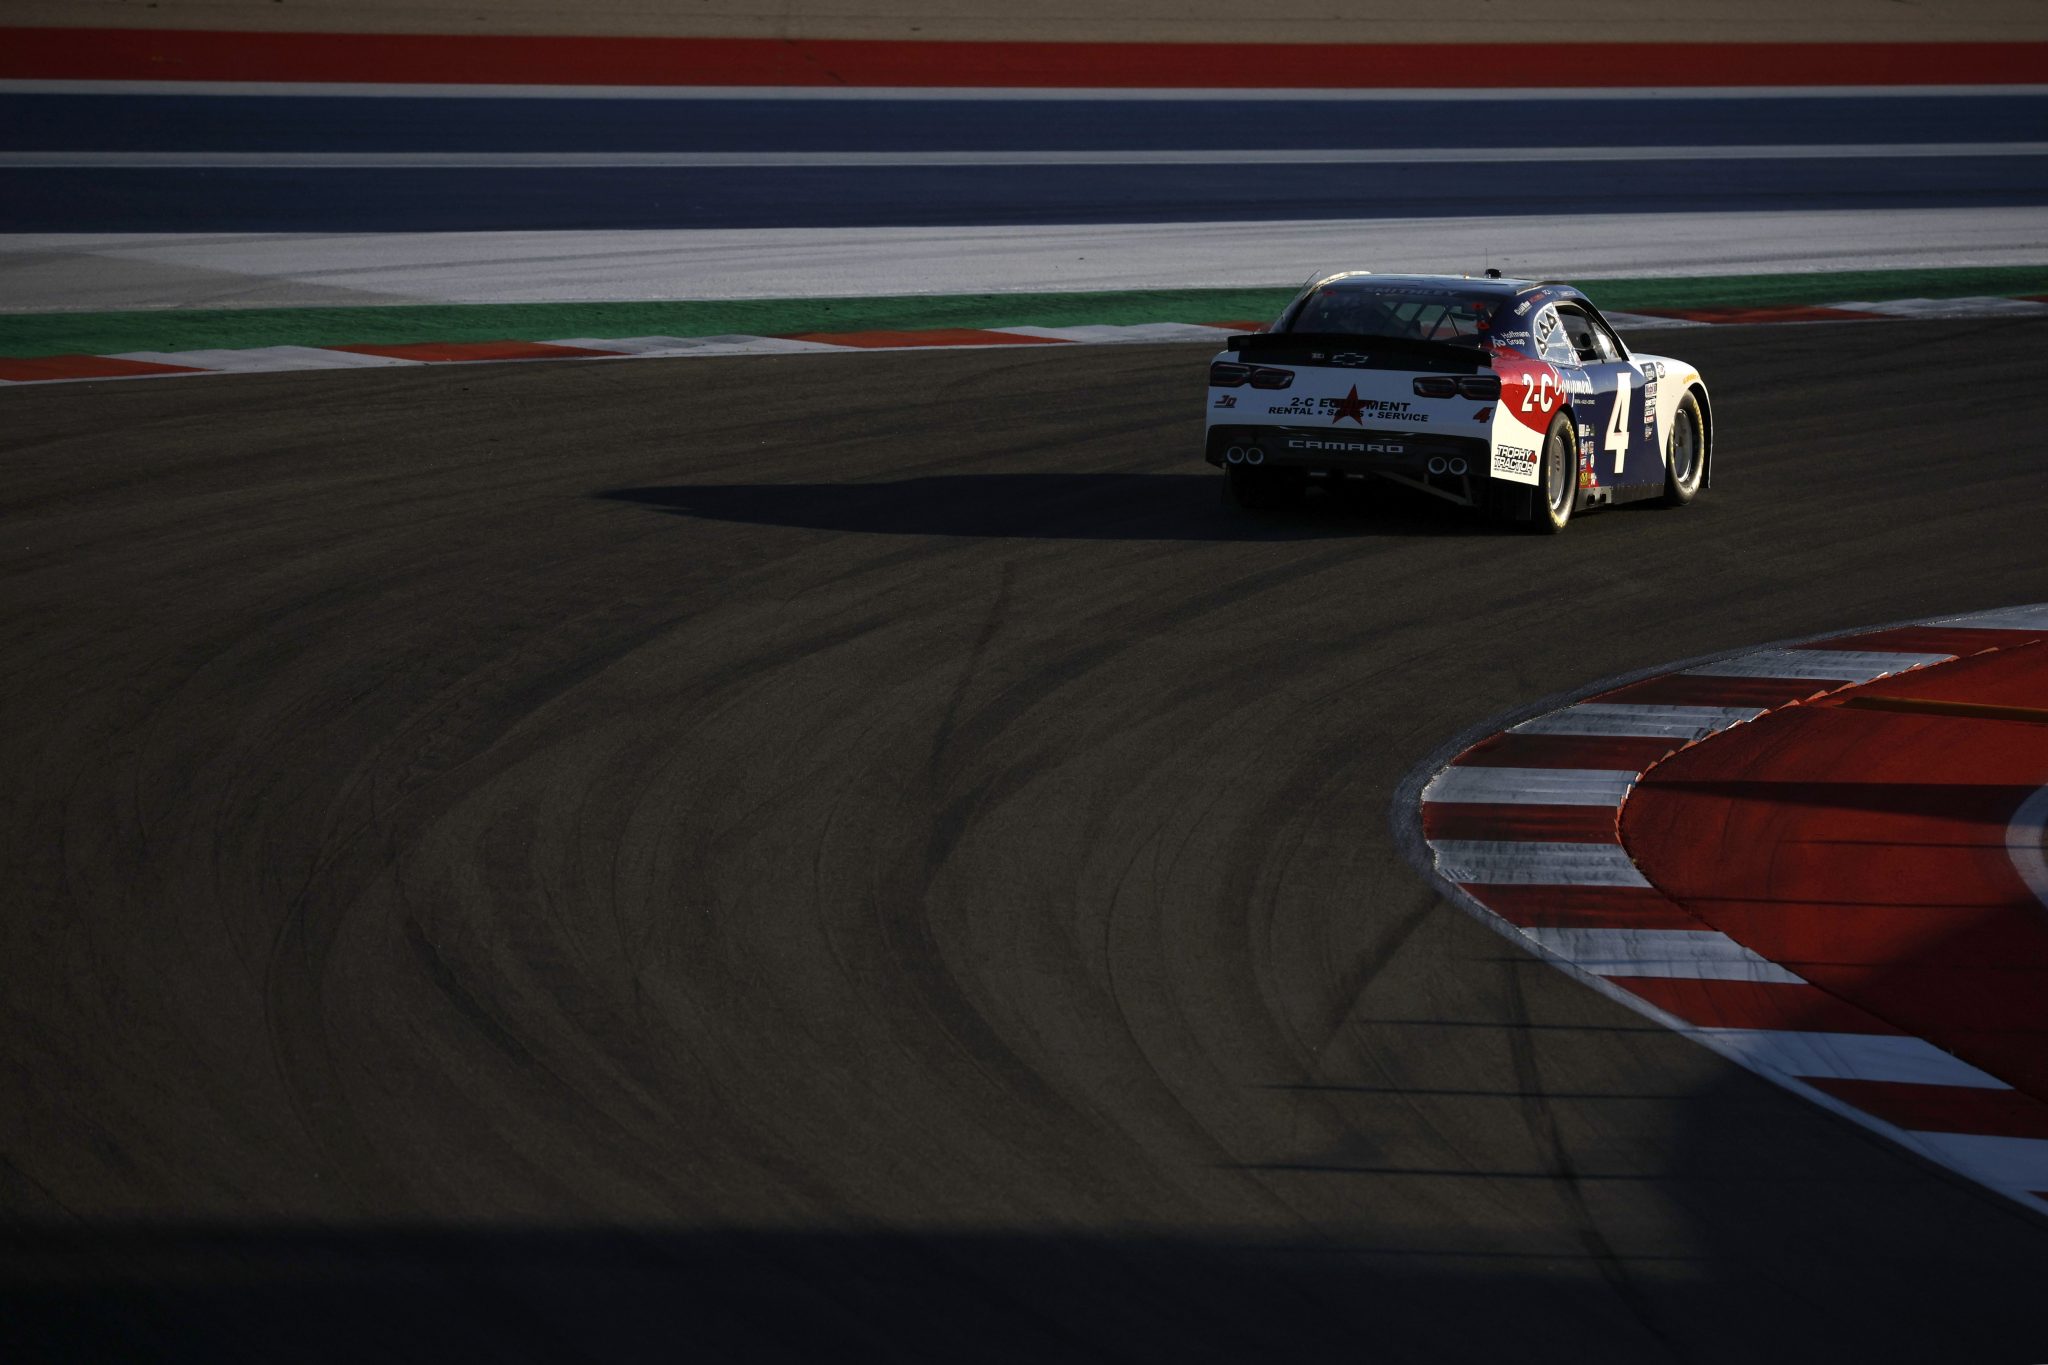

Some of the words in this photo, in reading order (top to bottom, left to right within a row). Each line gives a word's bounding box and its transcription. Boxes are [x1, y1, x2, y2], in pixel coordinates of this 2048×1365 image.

[1521, 373, 1553, 412] 2-C
[1290, 397, 1314, 407] 2-C
[1268, 407, 1313, 415] RENTAL
[1377, 411, 1429, 422] SERVICE
[1472, 406, 1495, 423] 4
[1604, 372, 1632, 473] 4
[1288, 439, 1404, 453] CAMARO
[1497, 444, 1535, 461] TROPHY
[1494, 455, 1534, 473] TRACTOR
